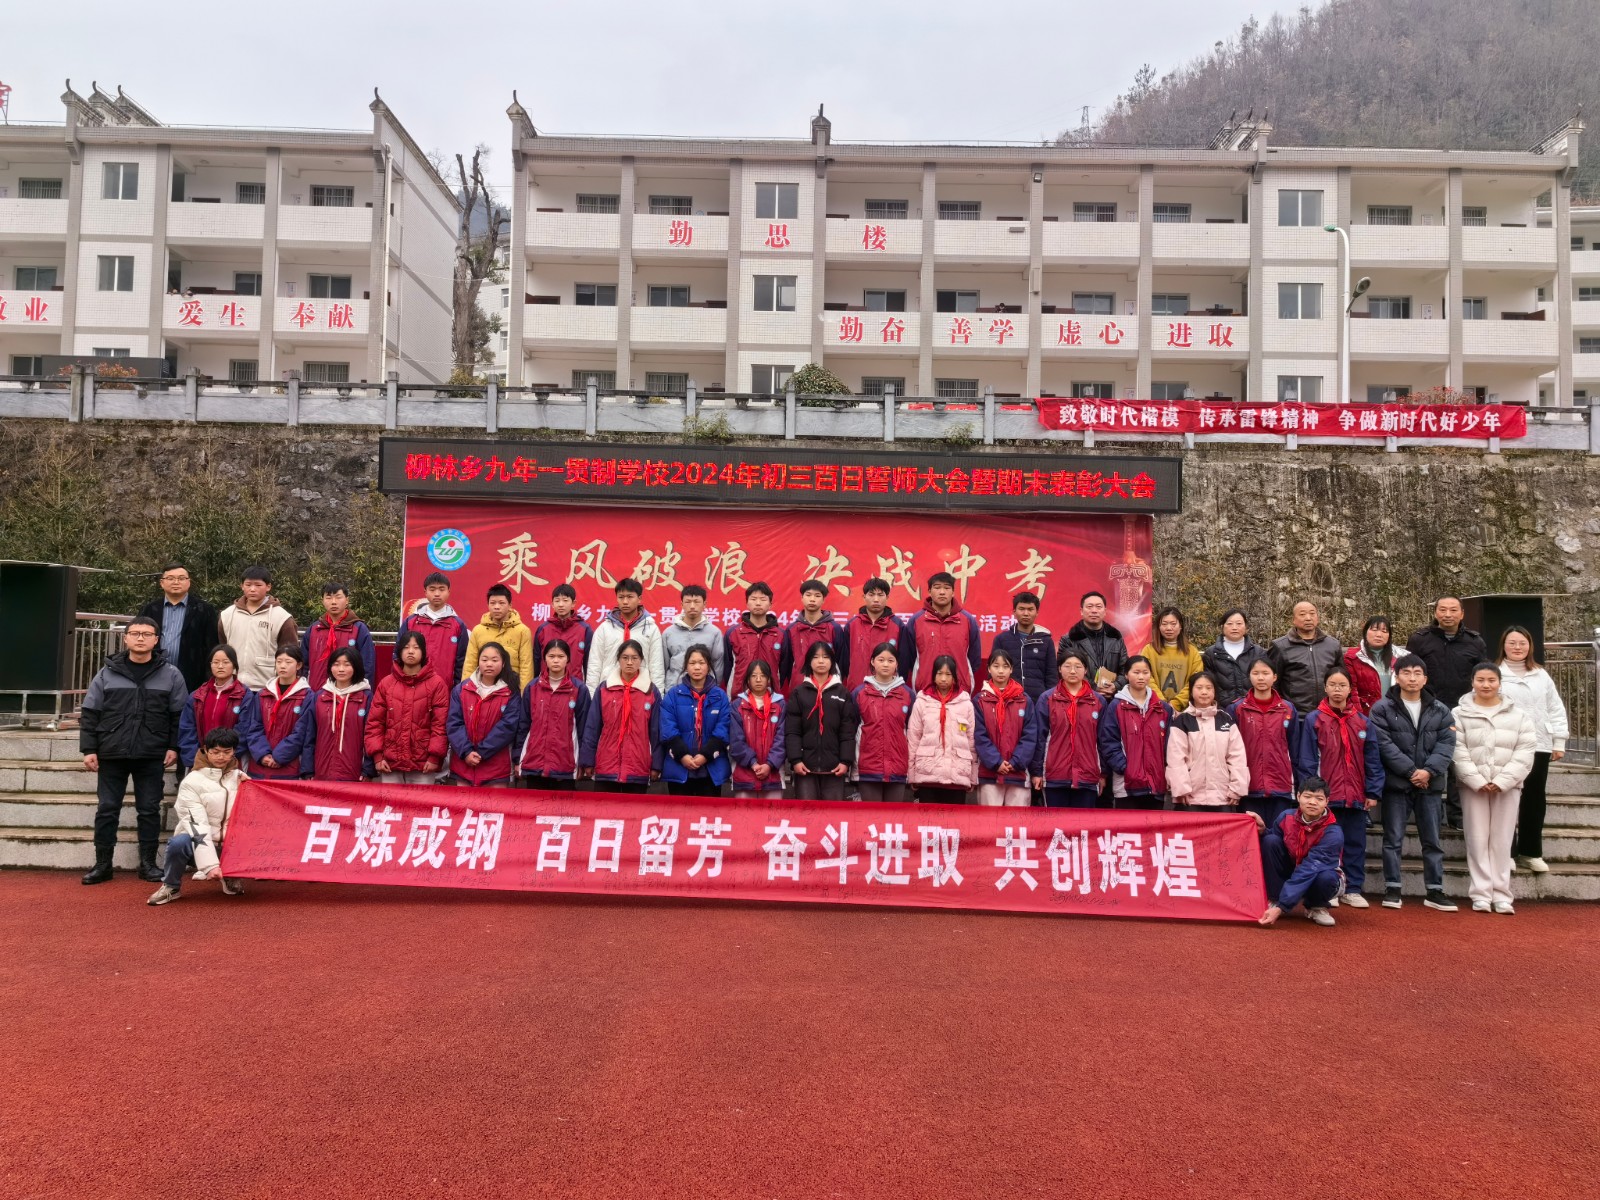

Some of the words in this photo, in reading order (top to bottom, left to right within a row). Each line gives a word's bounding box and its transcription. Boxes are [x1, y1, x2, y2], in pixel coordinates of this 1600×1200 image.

[668, 220, 887, 251] 勤思楼
[178, 300, 246, 327] 爱生
[291, 301, 354, 329] 奉献
[838, 316, 905, 343] 勤奋
[950, 318, 1015, 345] 善学
[1057, 320, 1125, 346] 虚心
[1167, 322, 1234, 348] 进取
[1059, 404, 1180, 428] 致敬时代楷模
[1199, 407, 1319, 430] 传承雷锋精神
[1338, 409, 1502, 432] 争做新时代好少年
[404, 453, 1156, 499] 柳林乡九年一贯制学校2024年初三百日誓师大会暨期末表彰大会
[496, 531, 752, 595] 乘风破浪
[801, 544, 1055, 604] 决战中考
[1161, 670, 1178, 694] A
[300, 804, 504, 871] 百炼成钢
[535, 815, 733, 878] 百日留芳
[762, 819, 964, 888] 奋斗进取
[994, 826, 1202, 899] 共创辉煌
